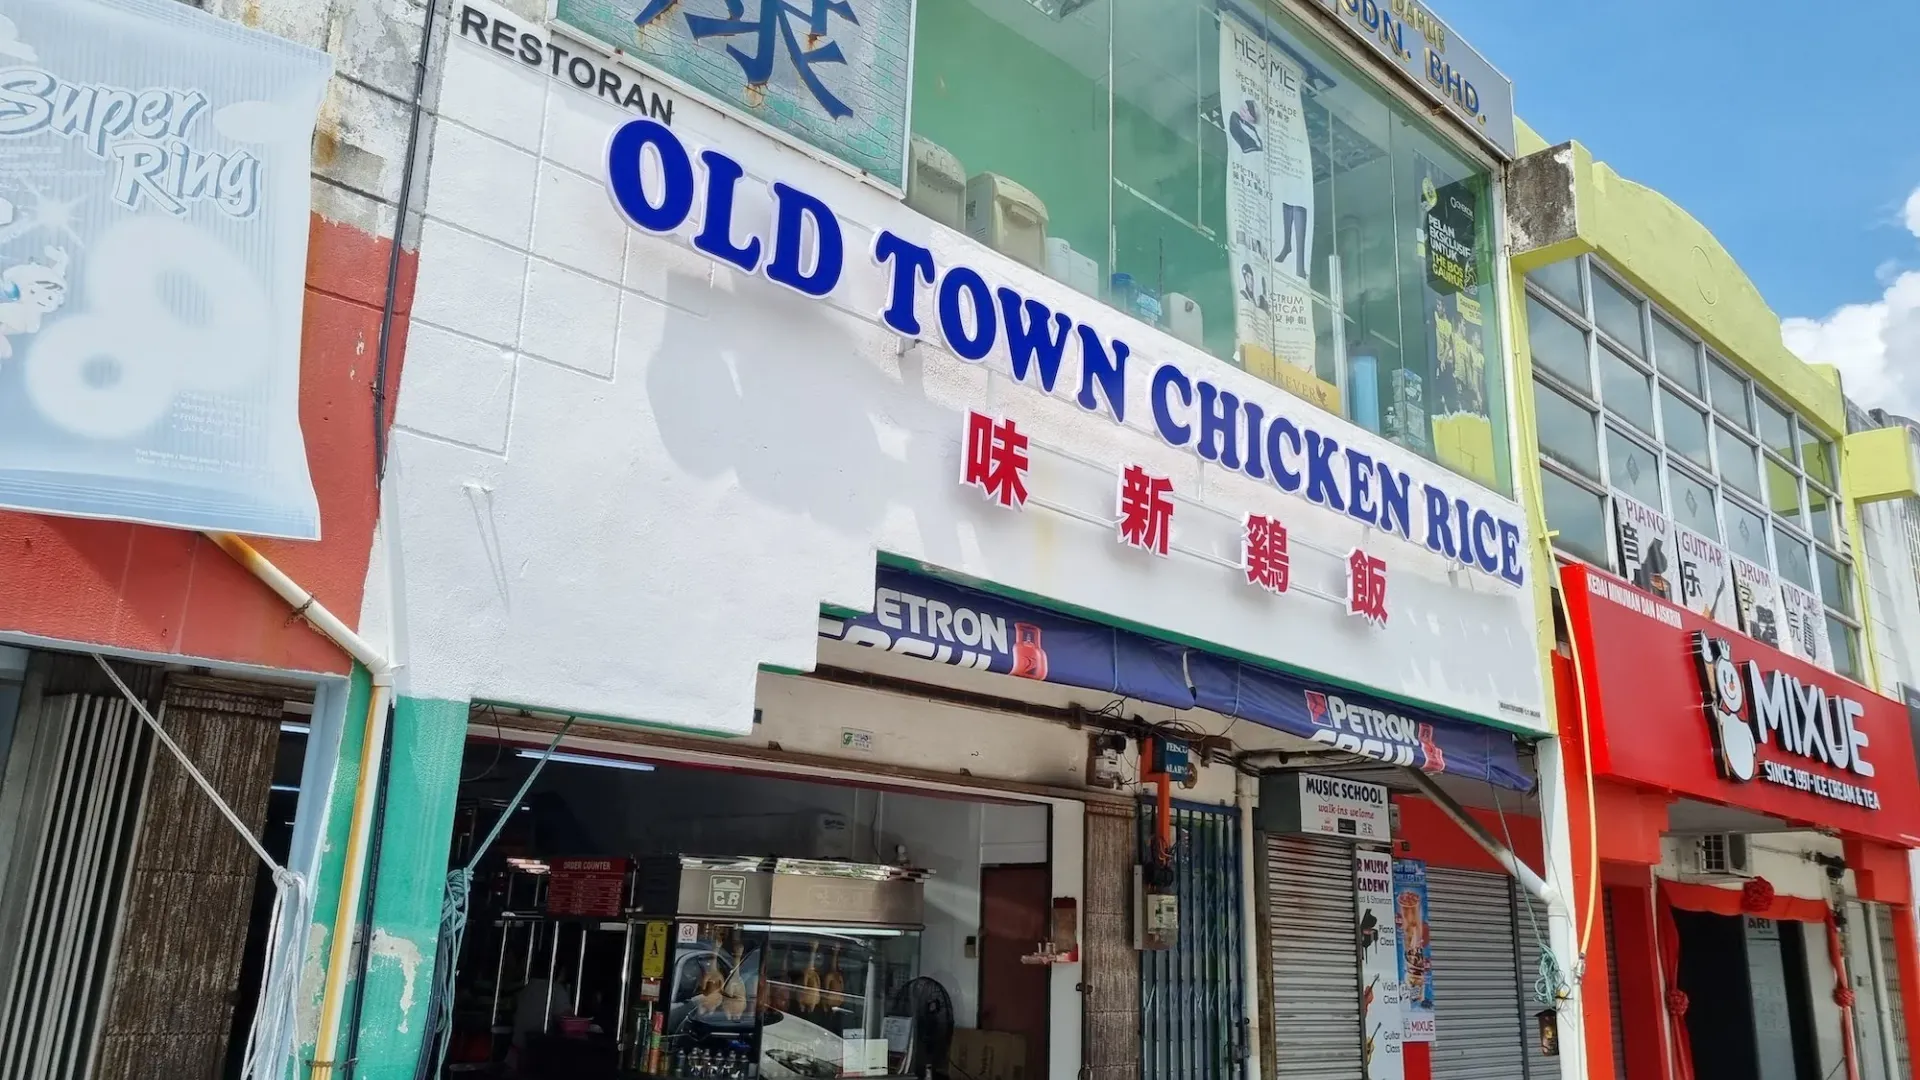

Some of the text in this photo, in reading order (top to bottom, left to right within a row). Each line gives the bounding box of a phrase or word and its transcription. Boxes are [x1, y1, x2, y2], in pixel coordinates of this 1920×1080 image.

[460, 5, 673, 126] RESTORAN
[1424, 47, 1487, 126] BHD.
[0, 68, 207, 156] Super
[112, 139, 260, 218] Ring
[1428, 214, 1454, 238] PELAN
[1429, 226, 1471, 258] EKSKLUSIF
[1430, 241, 1458, 263] UNTUK
[607, 118, 1524, 588] OLD TOWN CHICKEN RICE
[1625, 498, 1665, 535] PIANO
[1681, 531, 1722, 567] GUITAR
[1586, 572, 1609, 600] KEDAI
[1683, 560, 1702, 597] 乐
[1739, 559, 1771, 588] DRUM
[877, 587, 1008, 654] ETRON
[1328, 695, 1419, 747] PETRON
[1750, 660, 1875, 777] MIXUE
[1306, 778, 1383, 804] MUSIC SCHOOL
[1764, 760, 1794, 787] SINCE
[1828, 778, 1857, 804] CREAM
[1862, 788, 1881, 811] TEA
[582, 861, 611, 871] COUNTER
[1363, 859, 1389, 875] MUSIC
[1357, 878, 1390, 893] CADEMY
[1379, 924, 1394, 934] Piano
[1380, 937, 1395, 947] Class
[1382, 982, 1398, 992] Violin
[1383, 995, 1398, 1005] Class
[1384, 1031, 1400, 1041] Guitar
[1411, 1021, 1434, 1032] MIXUE
[1386, 1044, 1400, 1054] Class
